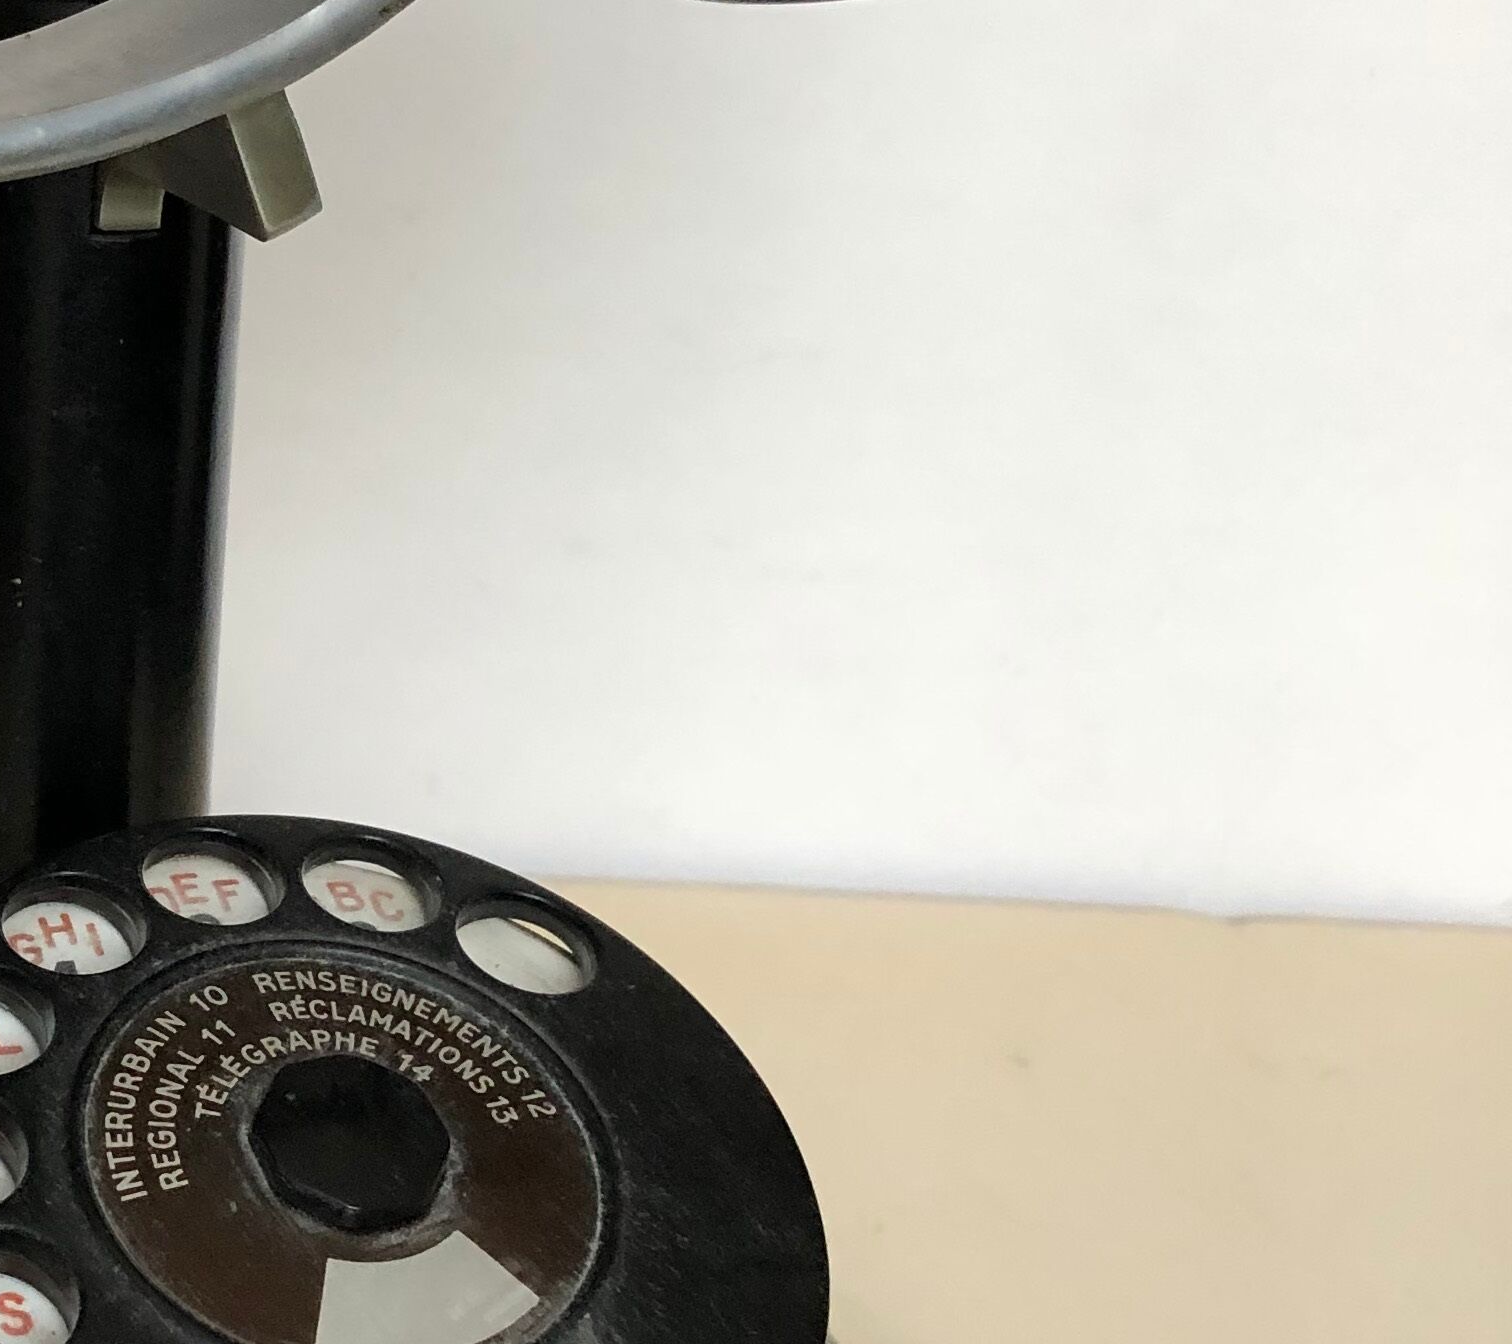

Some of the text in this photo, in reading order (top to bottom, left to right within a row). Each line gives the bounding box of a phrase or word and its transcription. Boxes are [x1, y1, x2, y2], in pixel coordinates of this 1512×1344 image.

[326, 880, 405, 923] BC
[104, 1010, 187, 1202] INTERURBAIN
[189, 985, 229, 1012] 10
[147, 1019, 236, 1191] REGIONAL 11
[194, 1029, 435, 1119] TÉLÉGRAPHE 14
[251, 970, 557, 1119] RENSEIGNEMENTS 12
[268, 993, 519, 1125] RÉCLAMATIONS 13
